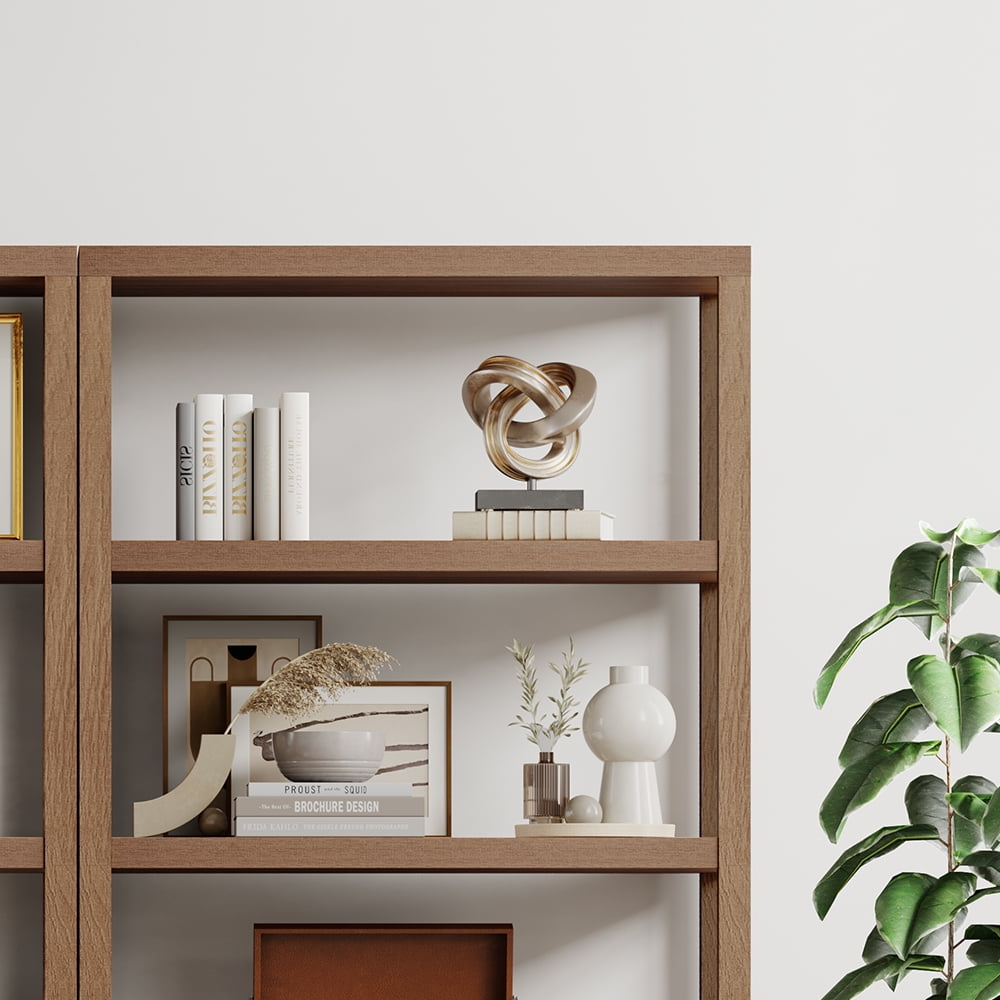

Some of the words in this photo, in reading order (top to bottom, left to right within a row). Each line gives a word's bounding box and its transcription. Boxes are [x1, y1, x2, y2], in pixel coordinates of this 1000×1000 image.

[284, 785, 321, 794] PROUST
[344, 785, 367, 794] SQUID
[294, 801, 344, 813] BROCHURE
[346, 801, 379, 813] DESIGN
